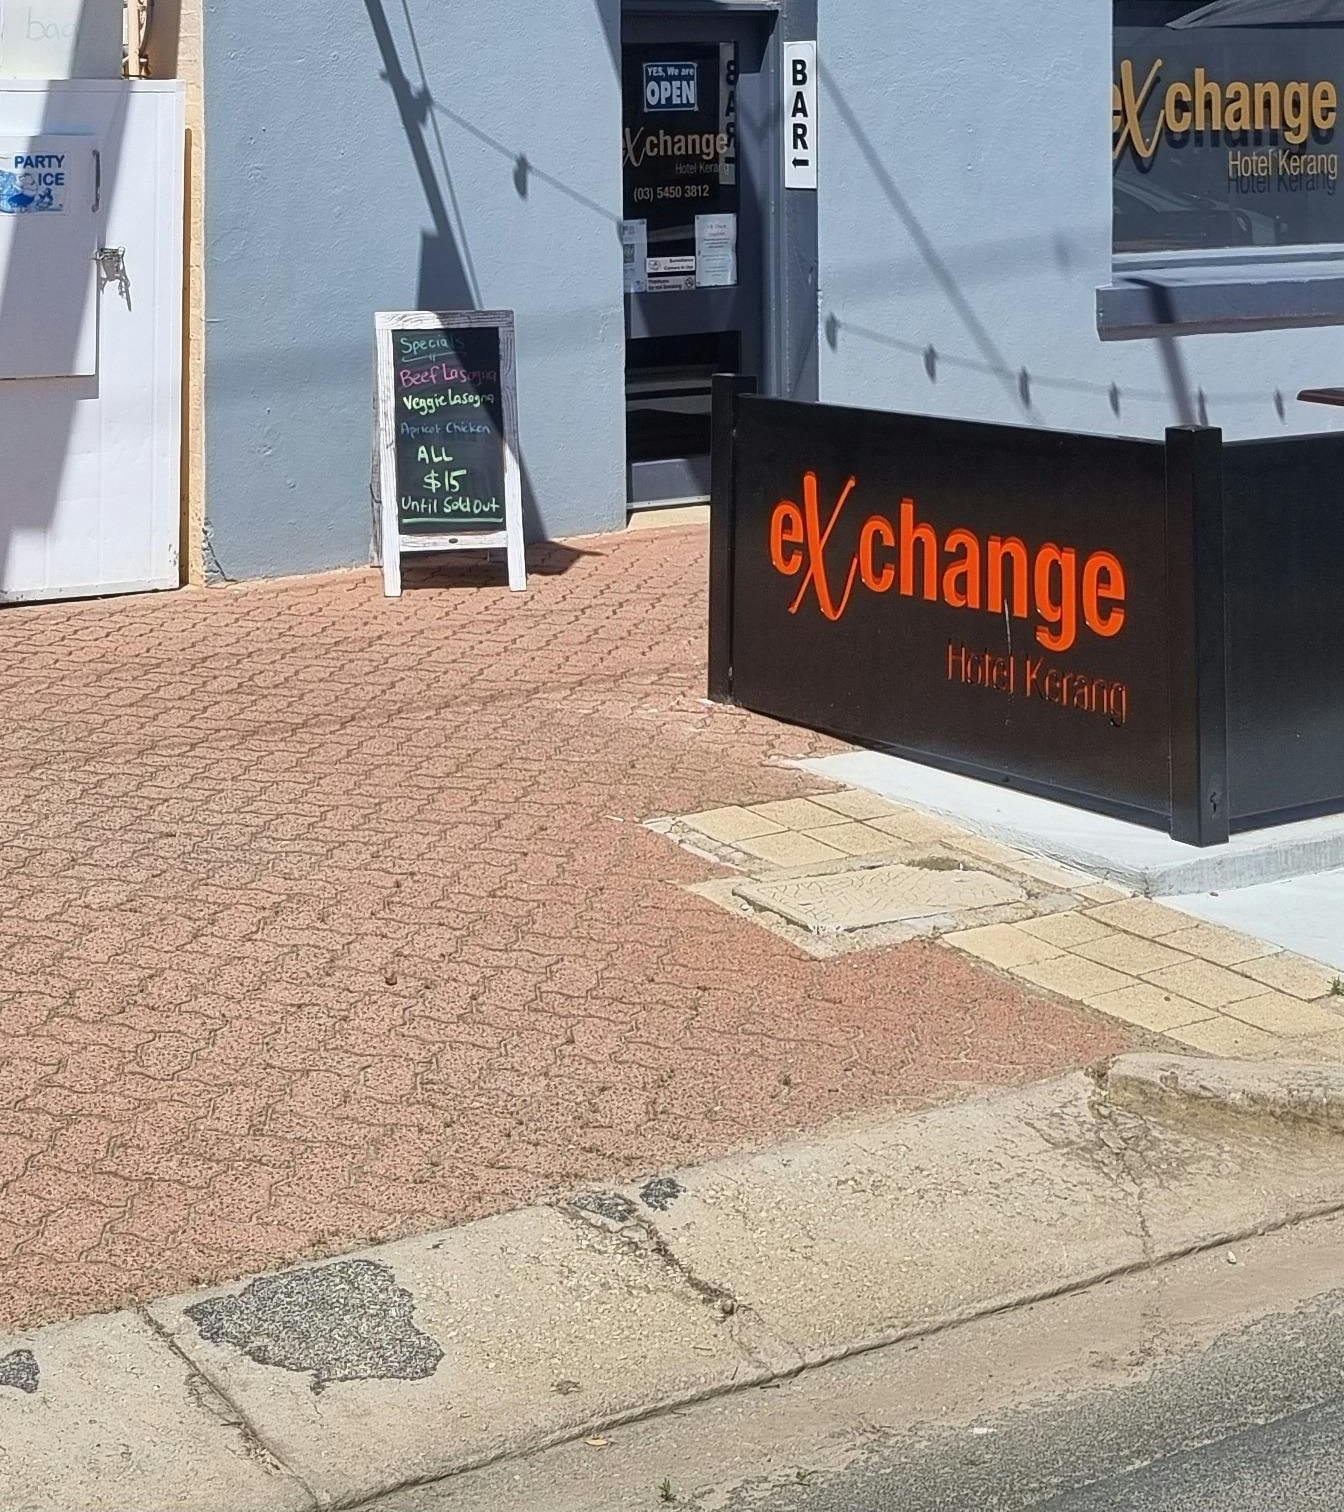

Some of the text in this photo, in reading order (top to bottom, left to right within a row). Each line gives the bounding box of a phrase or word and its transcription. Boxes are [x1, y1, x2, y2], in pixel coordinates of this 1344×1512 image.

[647, 67, 695, 78] YES, We are
[646, 80, 695, 105] OPEN
[790, 58, 809, 150] BAR
[623, 126, 728, 168] Xchange
[14, 154, 66, 169] PARTY
[675, 162, 697, 175] Hotel
[1228, 149, 1339, 181] Hotel Kerang
[38, 172, 65, 186] ICE
[633, 184, 710, 202] (03) 5450 3812
[399, 365, 440, 388] Beef
[403, 393, 447, 416] Veggie
[400, 421, 491, 439] Apricot Chicken
[417, 445, 454, 464] ALL
[423, 469, 468, 492] $15
[401, 496, 500, 514] Until Sold Out
[769, 469, 1127, 653] eXchange
[945, 638, 1129, 728] Hotel Kerang
